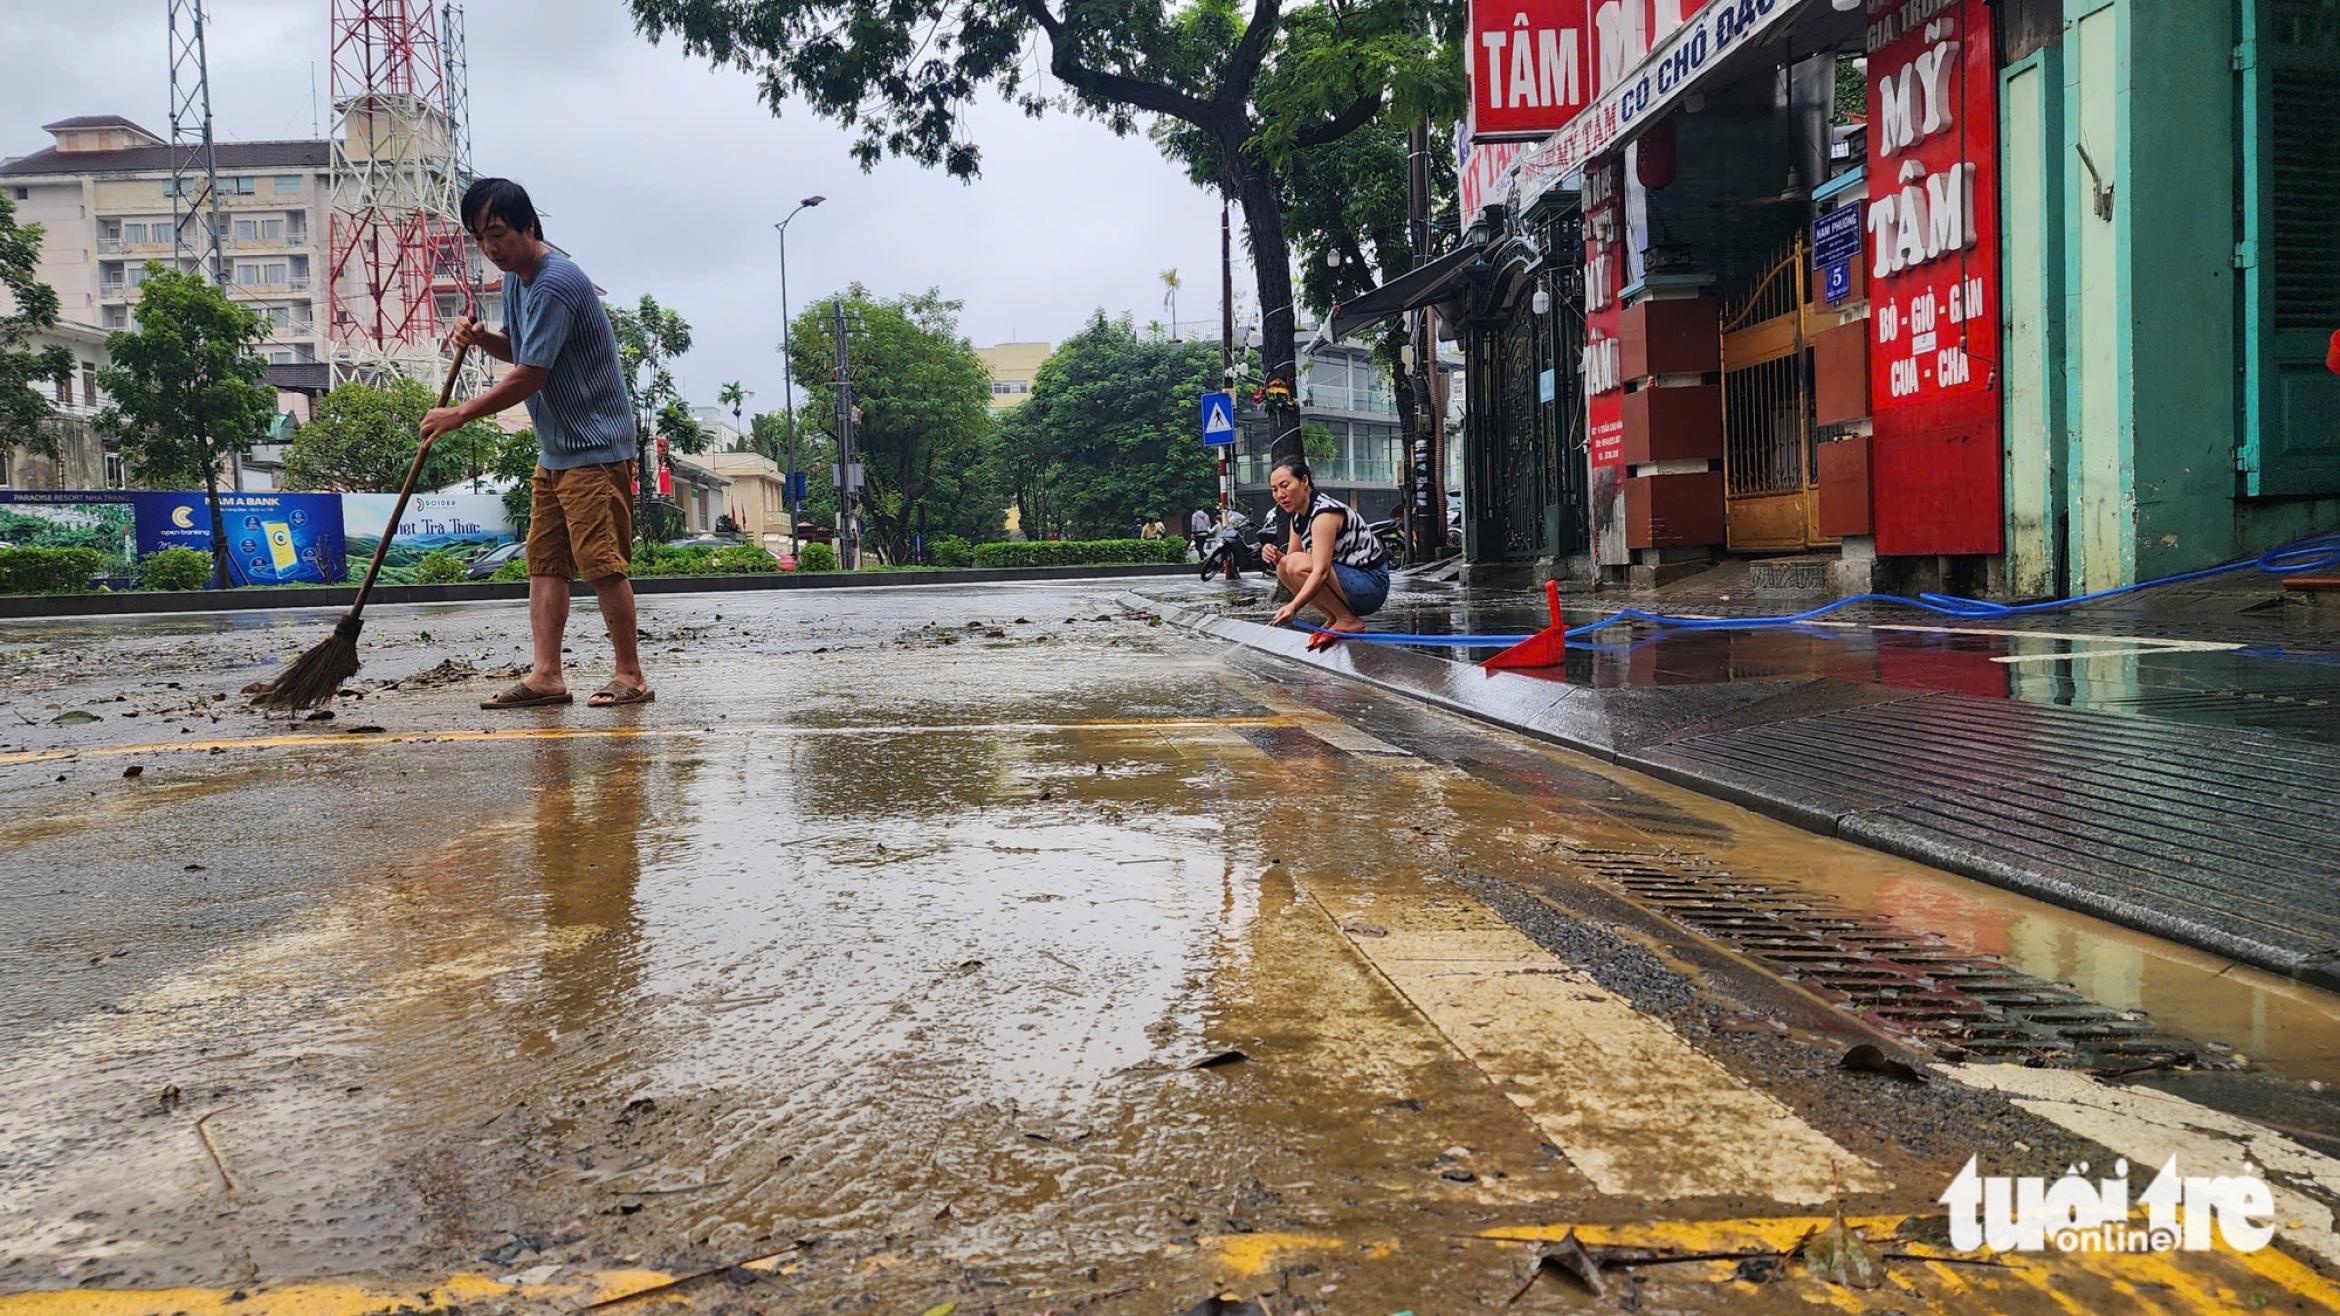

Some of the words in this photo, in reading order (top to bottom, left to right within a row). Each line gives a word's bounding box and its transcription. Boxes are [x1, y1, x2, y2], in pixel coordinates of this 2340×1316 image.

[1866, 14, 1893, 53] GIA
[1482, 12, 1580, 109] TÂM
[1880, 17, 1949, 157] MỸ
[1583, 101, 1617, 156] TÂM
[1622, 72, 1649, 122] CÓ
[1868, 159, 1963, 279] TÂM
[1832, 266, 1843, 287] 5
[1879, 297, 1898, 343] BÒ
[1911, 285, 1936, 335] GIÒ
[1891, 356, 1919, 397] CUA
[236, 497, 245, 506] A
[246, 497, 280, 506] BANK
[160, 529, 180, 537] open
[180, 529, 211, 537] banking
[421, 518, 446, 535] Trà
